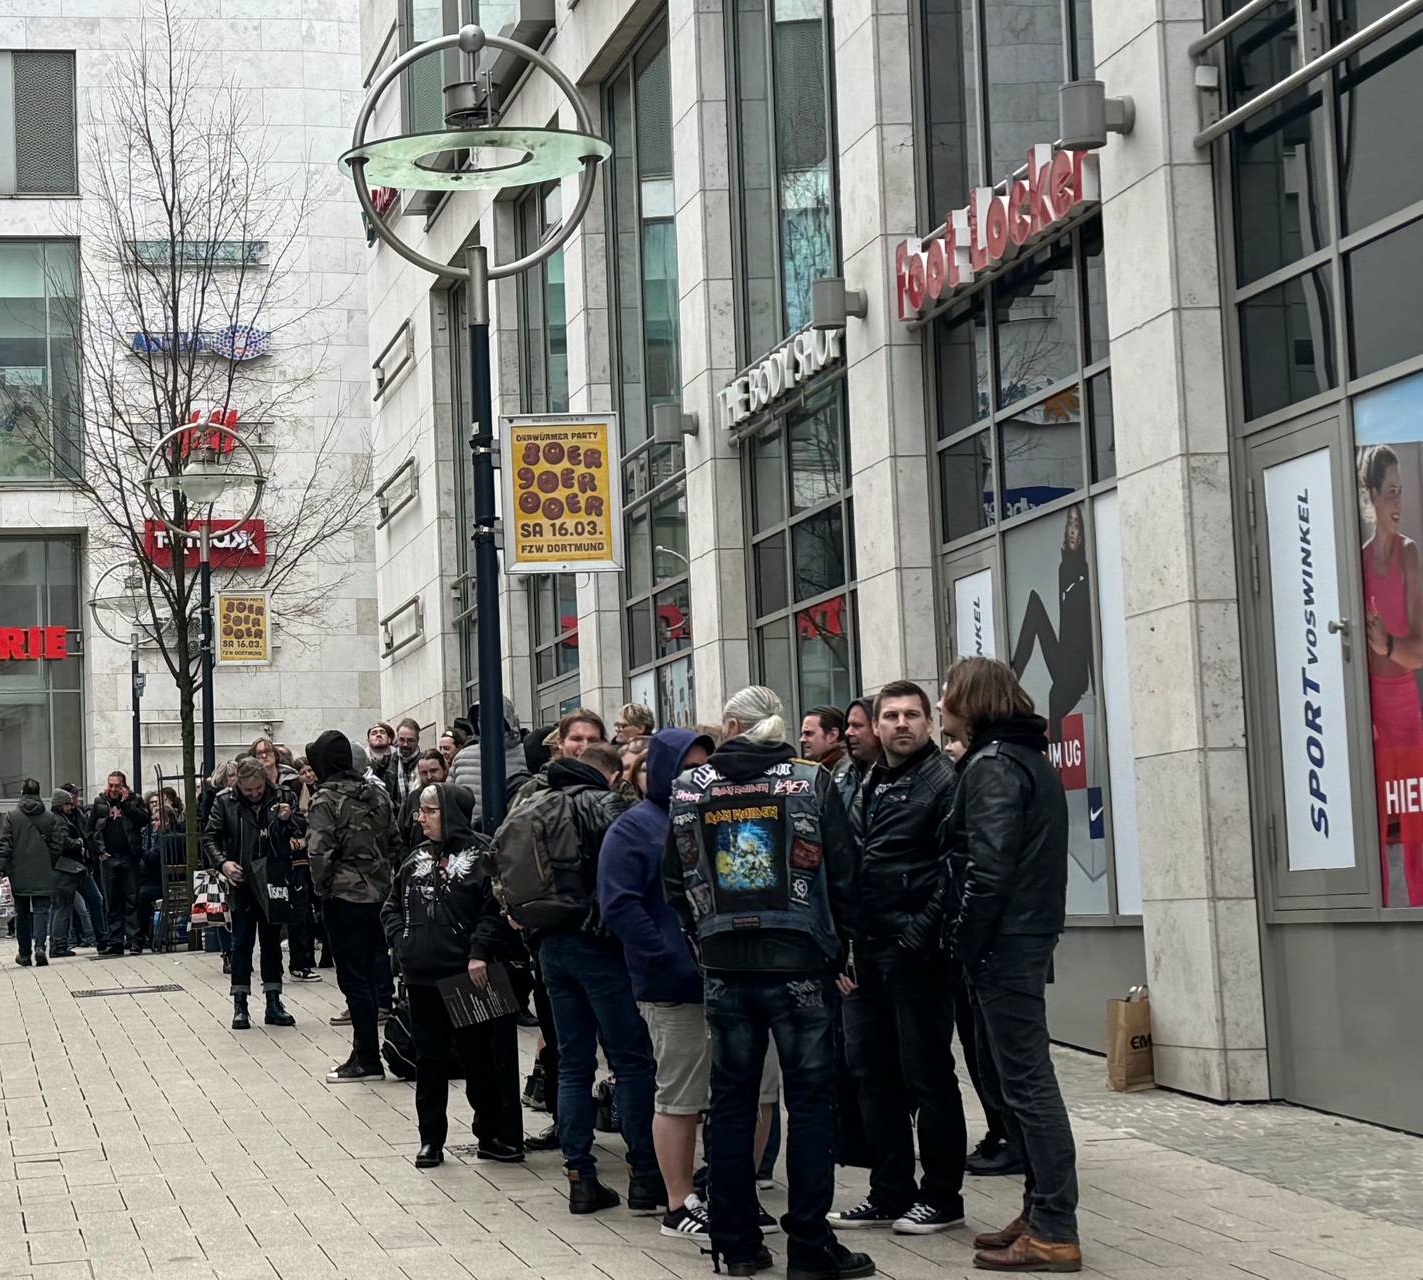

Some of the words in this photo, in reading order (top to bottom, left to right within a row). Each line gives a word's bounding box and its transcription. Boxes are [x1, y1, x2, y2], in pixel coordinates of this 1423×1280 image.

[969, 143, 1100, 272] Locker
[717, 376, 751, 430] THE
[748, 342, 796, 412] BODY
[571, 431, 599, 441] PARTY
[520, 522, 544, 538] SA
[550, 520, 604, 538] 16.03.
[521, 544, 544, 554] FZW
[546, 542, 605, 553] DORTMUND
[1298, 487, 1319, 665] VOSWINKEL
[223, 640, 234, 648] SA
[237, 640, 263, 648] 16.03.
[1064, 739, 1082, 767] UG
[1301, 666, 1329, 839] SPORT
[1385, 777, 1423, 814] HIE
